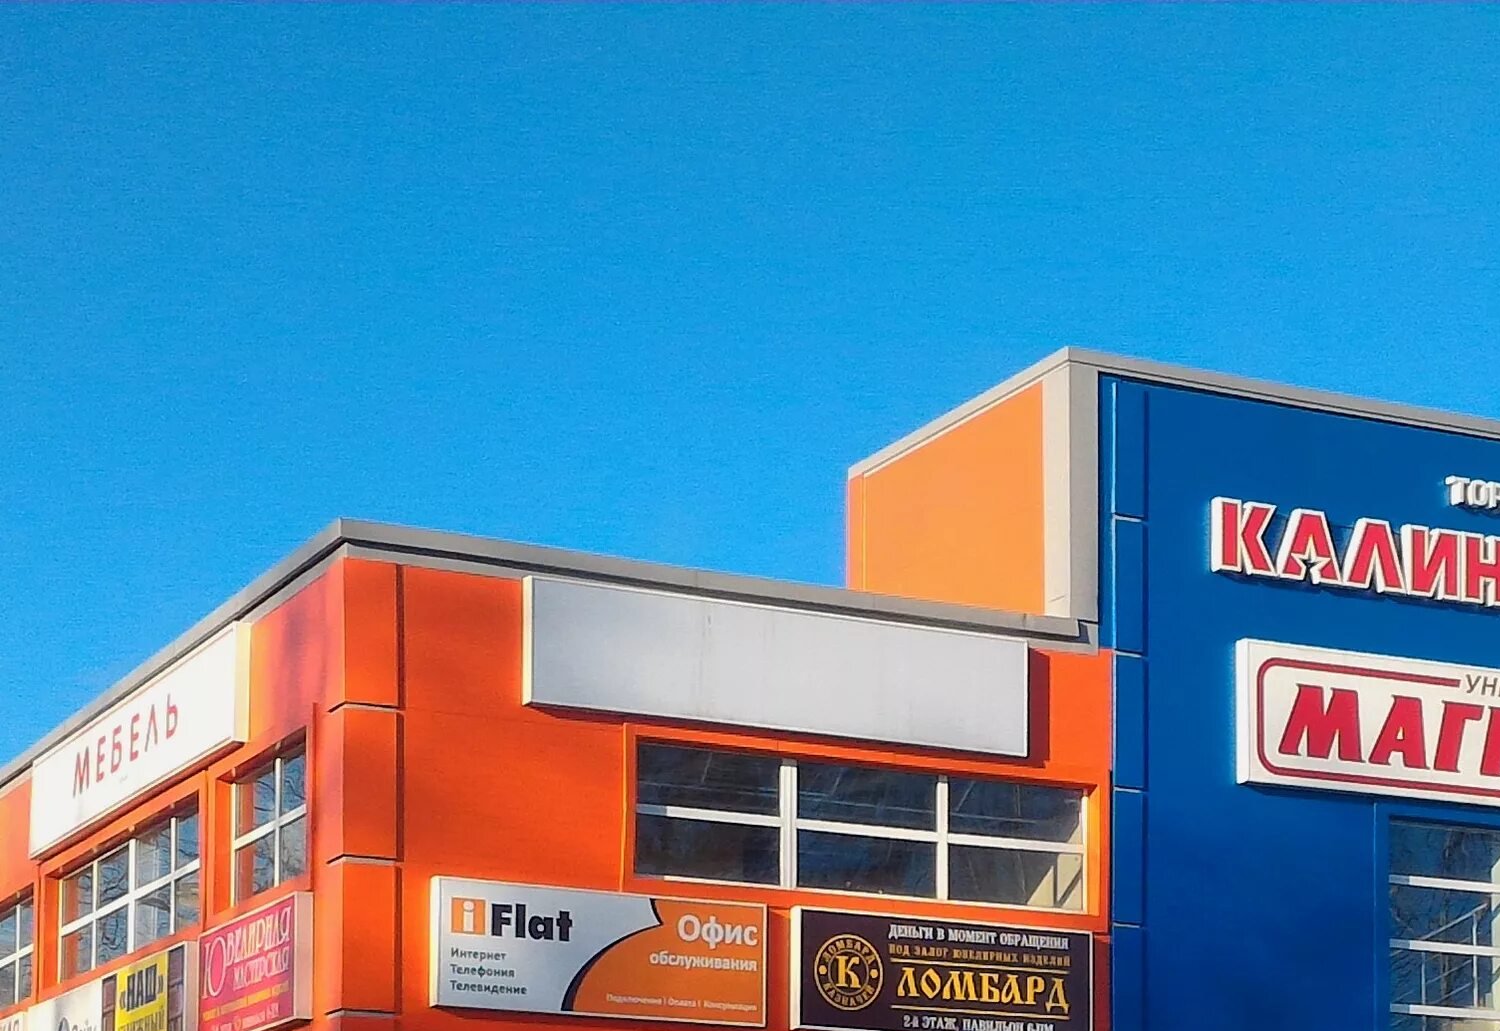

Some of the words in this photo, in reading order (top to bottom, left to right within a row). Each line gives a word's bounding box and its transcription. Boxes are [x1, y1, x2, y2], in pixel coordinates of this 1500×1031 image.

[73, 692, 179, 799] МЕБЕЛЬ
[677, 914, 758, 950] Офис
[888, 924, 934, 940] ДЕНЬГИ
[936, 927, 945, 941] В
[947, 929, 997, 946] МОМЕНТ
[1000, 933, 1069, 950] ОБРАЩЕНИЯ
[450, 947, 507, 962] Интернет
[649, 950, 758, 972] обслуживания
[889, 943, 911, 956] ПОД
[915, 945, 948, 958] ЗАЛОГ
[450, 963, 515, 979] Телефония
[835, 955, 861, 988] К
[450, 979, 528, 995] Телевидение
[897, 967, 1071, 1013] ЛОМБАРД
